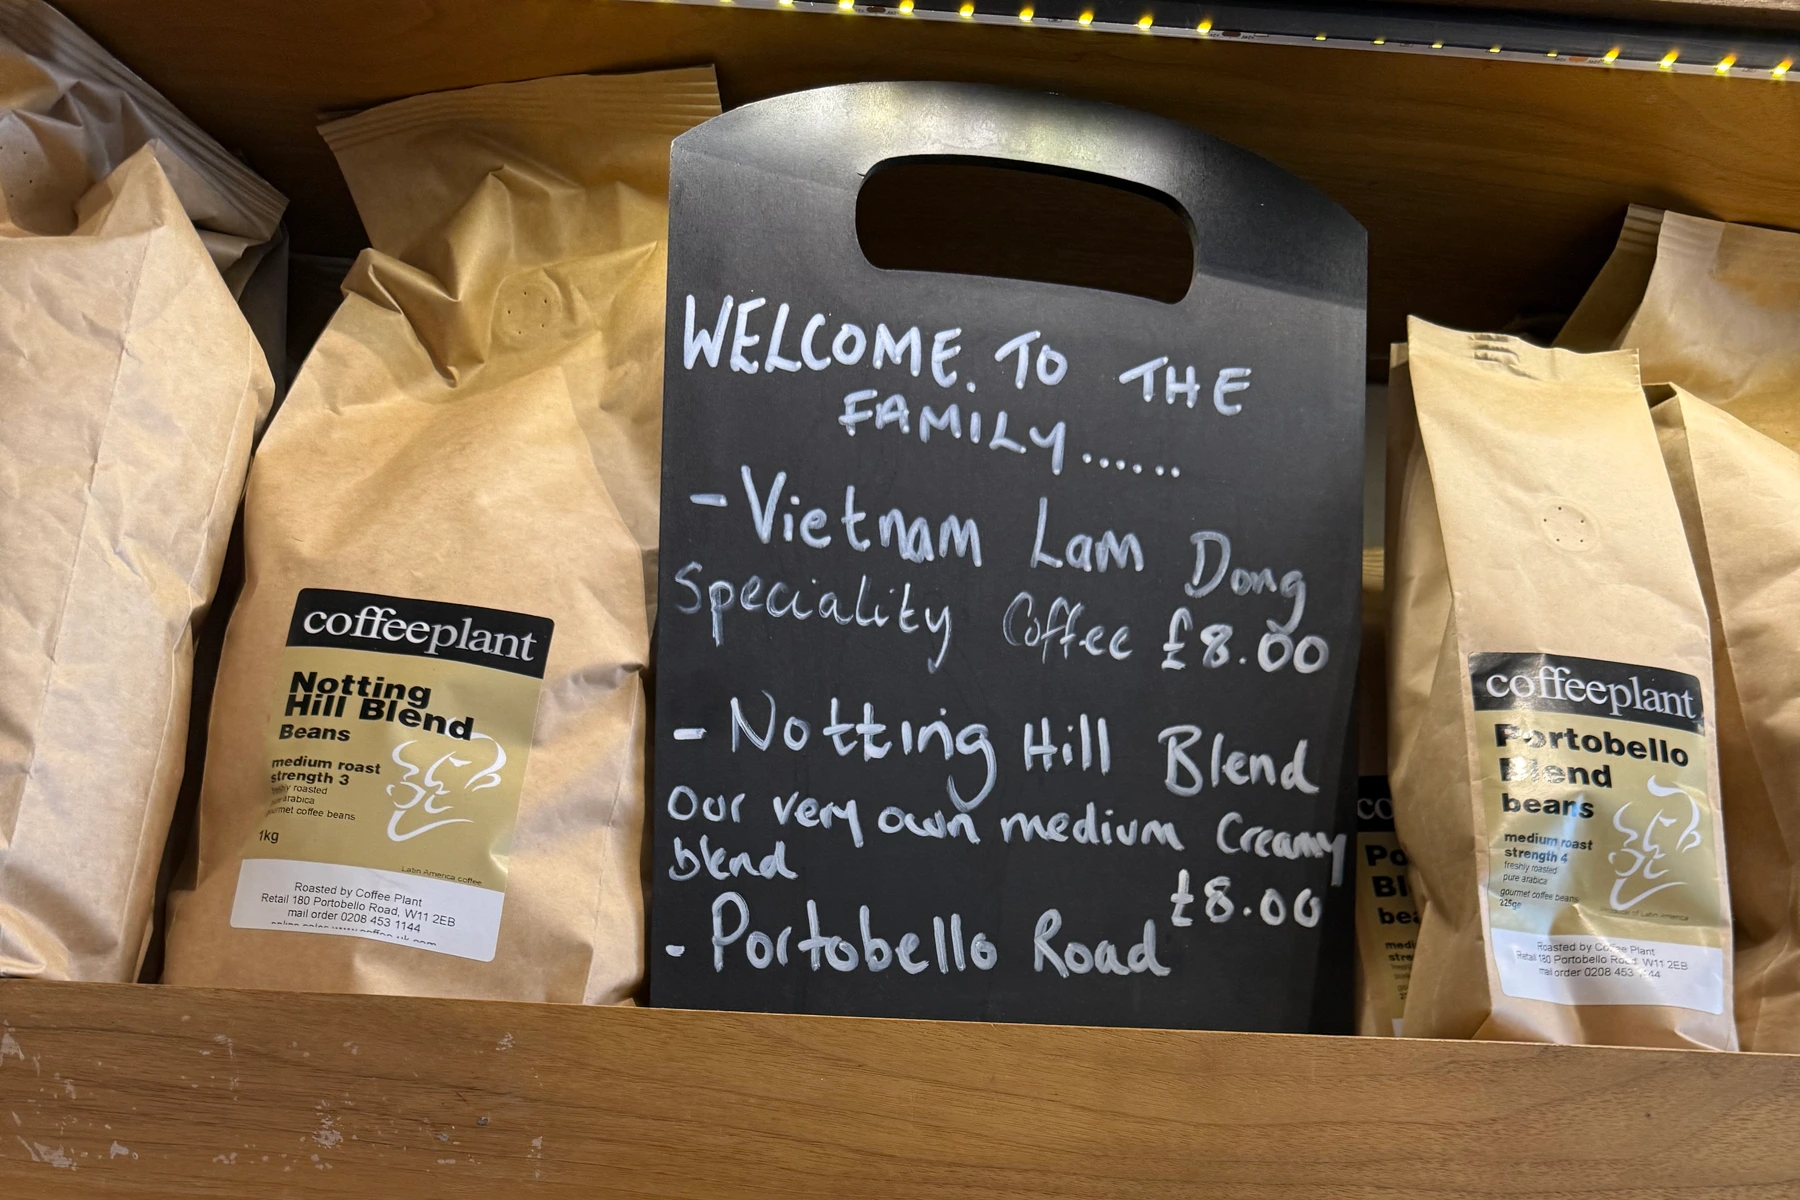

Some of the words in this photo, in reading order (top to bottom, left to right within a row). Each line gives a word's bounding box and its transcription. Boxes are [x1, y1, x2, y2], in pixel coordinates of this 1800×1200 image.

[995, 331, 1067, 389] TO
[1120, 357, 1252, 415] THE
[742, 465, 982, 567] Vietnam
[1031, 497, 1144, 572] Lam
[1184, 531, 1307, 634] Dong
[673, 561, 952, 674] Speciality
[1003, 592, 1131, 663] Coffee
[1162, 607, 1329, 673] £8.00
[302, 605, 538, 662] coffeeplant
[289, 671, 432, 709] Notting
[1486, 665, 1696, 719] coffeeplant
[284, 694, 347, 718] Hill
[359, 699, 474, 741] Blend
[278, 724, 351, 742] Beans
[1495, 723, 1689, 767] Portobello
[731, 691, 997, 808] Notting
[1024, 713, 1110, 775] Hill
[1158, 724, 1319, 797] Blend
[272, 756, 332, 768] medium
[338, 762, 381, 774] roast
[1500, 756, 1612, 788] Blend
[271, 771, 333, 784] strength
[339, 775, 350, 785] 3
[293, 785, 328, 794] roasted
[297, 808, 324, 817] coffee
[327, 810, 355, 820] beans
[1502, 793, 1594, 819] beans
[259, 830, 279, 844] 1kg
[668, 785, 745, 822] Our
[774, 794, 864, 848] very
[877, 806, 981, 845] own
[1000, 803, 1184, 851] medium
[1216, 813, 1347, 887] Creamy
[1504, 832, 1558, 846] medium
[1561, 839, 1593, 850] roast
[668, 837, 798, 881] blend
[1505, 848, 1557, 863] strength
[1560, 853, 1568, 863] 4
[401, 866, 422, 874] Latin
[423, 870, 456, 881] America
[458, 877, 482, 885] coffee
[1522, 876, 1547, 885] arabica
[1531, 864, 1557, 874] roasted
[295, 882, 337, 895] Roasted
[340, 885, 352, 897] by
[356, 888, 391, 901] Coffee
[394, 894, 422, 907] Plant
[1171, 868, 1321, 928] £8.00
[1500, 888, 1530, 899] gourmet
[262, 893, 289, 904] Retail
[293, 896, 310, 906] 180
[313, 897, 365, 911] Portobello
[405, 909, 428, 921] W11
[433, 914, 456, 927] 2EB
[288, 909, 308, 919] mail
[312, 910, 338, 921] order
[340, 912, 367, 924] 0208
[370, 916, 391, 927] 453
[396, 921, 421, 933] 1144
[712, 892, 997, 974] Portobello
[1034, 908, 1171, 978] Road
[1537, 942, 1576, 951] Roasted
[1579, 943, 1592, 953] by
[1630, 945, 1655, 955] Plant
[1554, 954, 1607, 964] Portobello
[1643, 958, 1664, 967] W11
[1668, 961, 1688, 970] 2EB
[1554, 968, 1581, 977] order
[1585, 968, 1611, 977] 0208
[1614, 968, 1633, 977] 453
